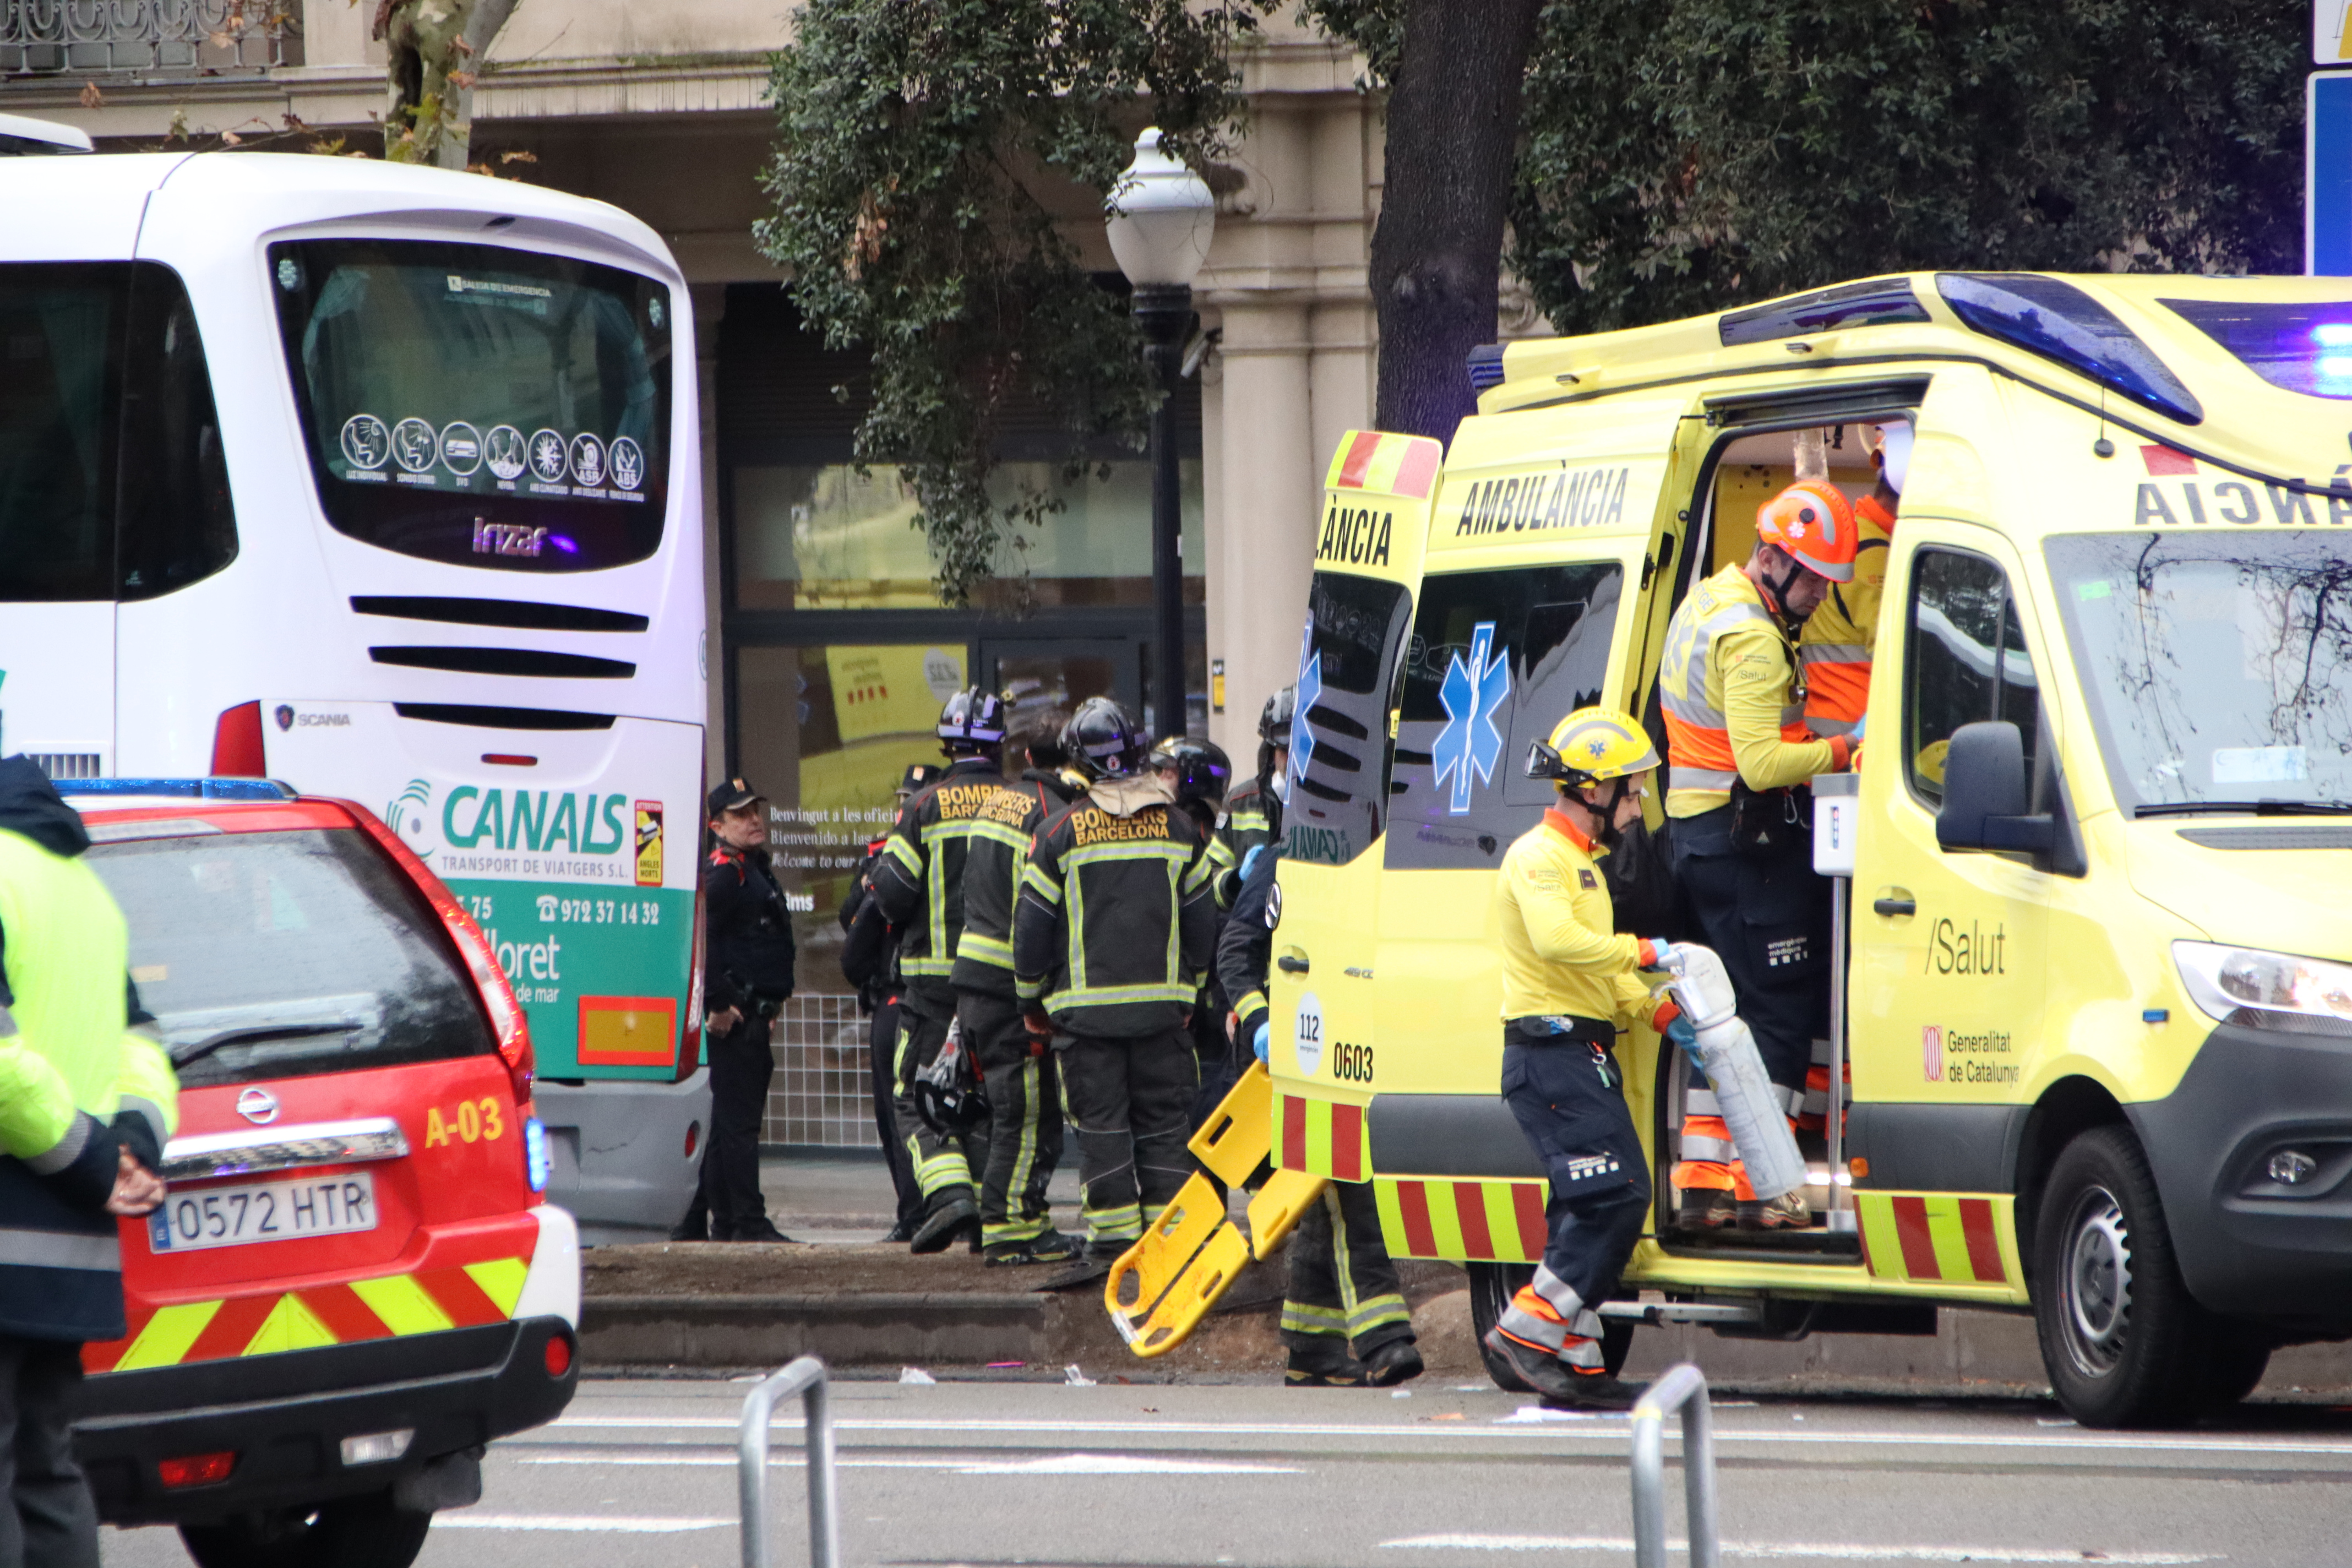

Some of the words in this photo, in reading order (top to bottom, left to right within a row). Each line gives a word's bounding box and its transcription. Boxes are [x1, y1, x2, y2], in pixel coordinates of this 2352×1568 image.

[579, 469, 599, 483] ASR
[617, 471, 637, 486] ABS
[1456, 459, 1629, 536] AMBULÀNCIA
[1315, 494, 1392, 567] ÀNCIA
[1693, 582, 1715, 611] ETGE
[298, 714, 351, 726] SCANIA
[442, 785, 628, 855] CANALS
[770, 806, 829, 825] Benvingut
[832, 812, 840, 822] a
[843, 807, 861, 822] les
[771, 830, 838, 846] Bienvenido
[841, 835, 849, 845] a
[853, 831, 872, 846] las
[1075, 824, 1169, 846] BARCELONA
[442, 856, 518, 873] TRANSPORT
[523, 859, 538, 874] DE
[545, 860, 604, 877] VIATGERS
[608, 863, 628, 878] S.L.
[640, 859, 660, 869] ANGLES
[771, 852, 816, 868] Welcome
[819, 856, 832, 868] to
[835, 857, 856, 868] our
[640, 869, 658, 878] MORTS
[471, 896, 492, 919] 75
[561, 899, 591, 923] 972
[596, 900, 614, 924] 37
[621, 902, 638, 925] 14
[642, 902, 659, 925] 32
[1925, 918, 2006, 975] /Salut
[535, 987, 559, 1003] mar
[1300, 1013, 1319, 1042] 112
[1948, 1031, 2011, 1053] Generalitat
[1334, 1042, 1374, 1084] 0603
[1950, 1060, 1963, 1083] de
[1967, 1060, 2020, 1088] Catalunya
[425, 1097, 503, 1148] A-03
[177, 1191, 278, 1240] 0572
[291, 1182, 365, 1230] HTR
